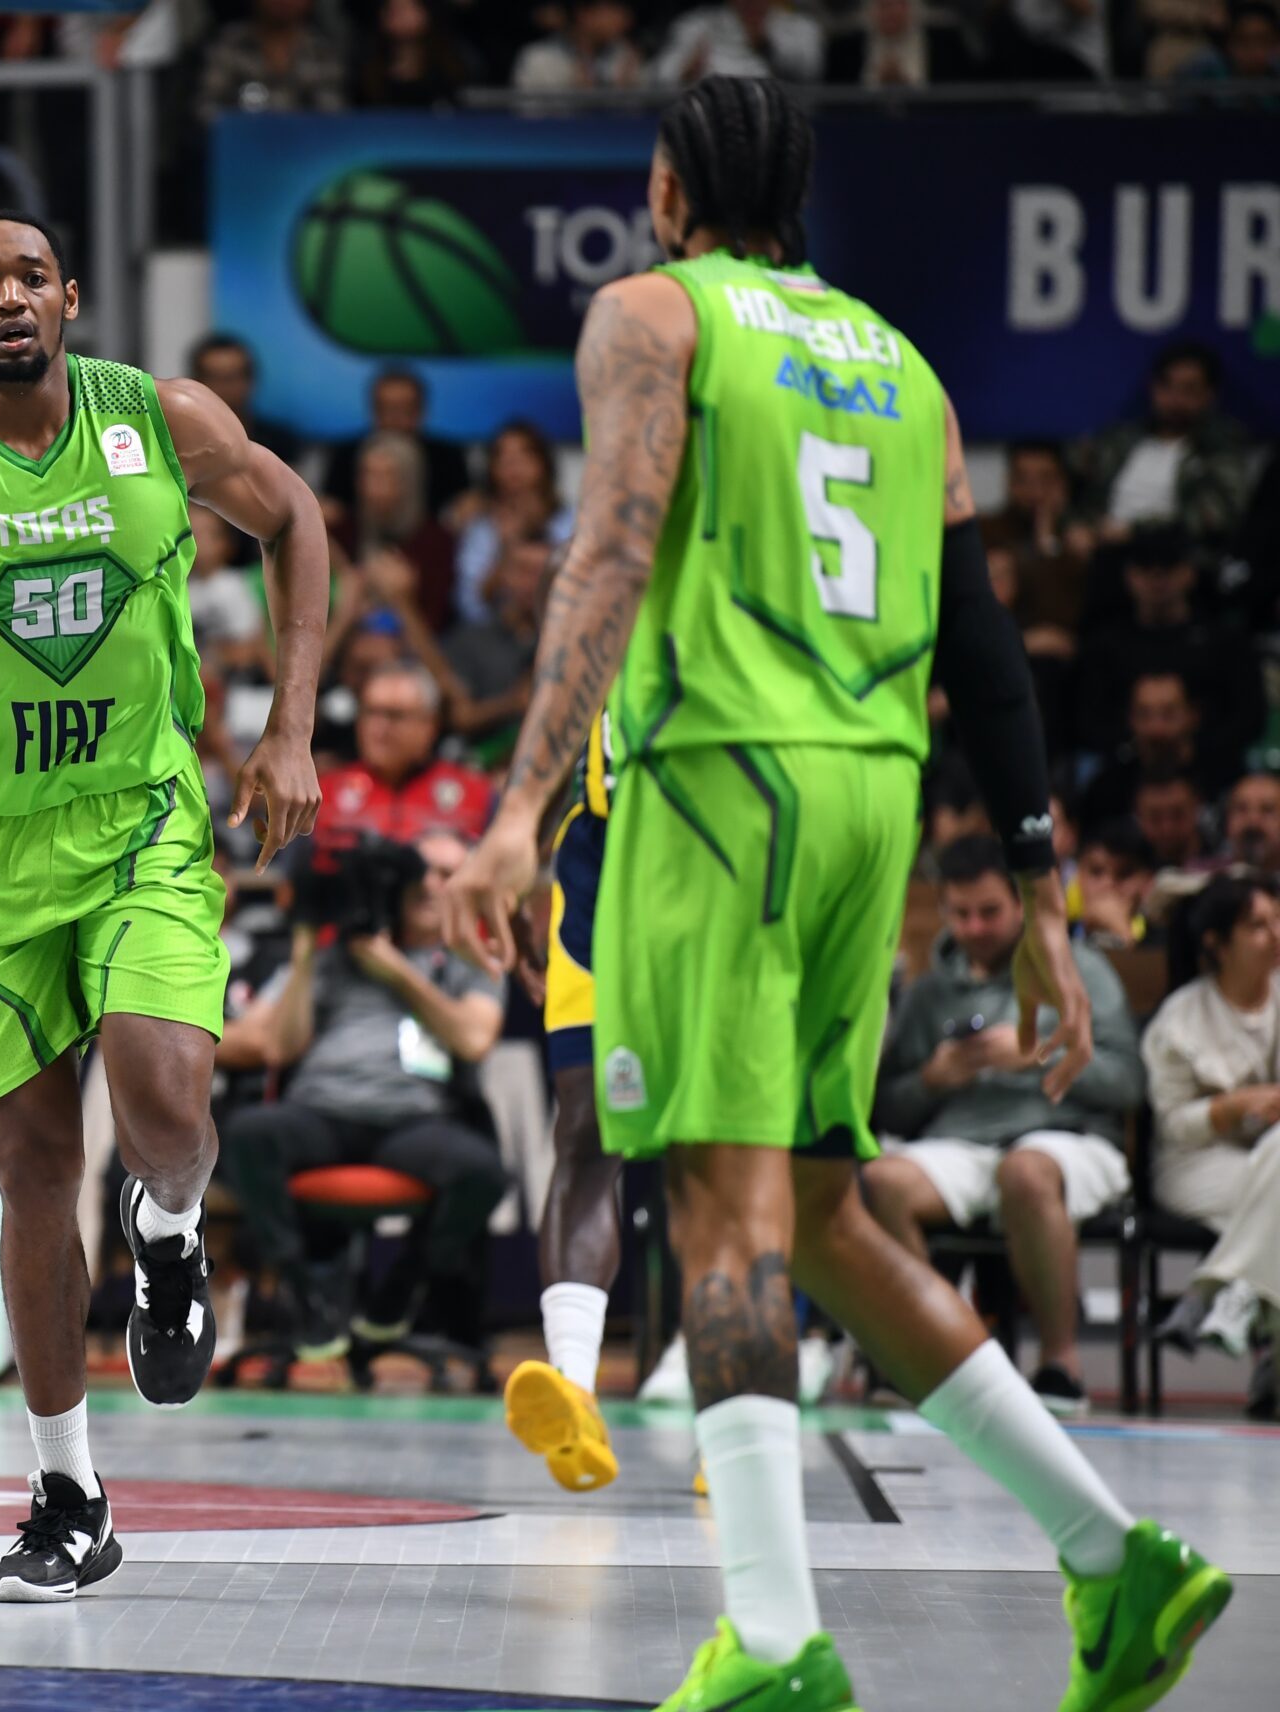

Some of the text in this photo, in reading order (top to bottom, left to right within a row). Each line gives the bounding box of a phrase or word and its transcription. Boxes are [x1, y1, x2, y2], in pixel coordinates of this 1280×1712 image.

[775, 351, 902, 421] AYGAZ
[796, 429, 879, 623] 5
[11, 567, 105, 640] 50
[11, 697, 116, 775] FIAT
